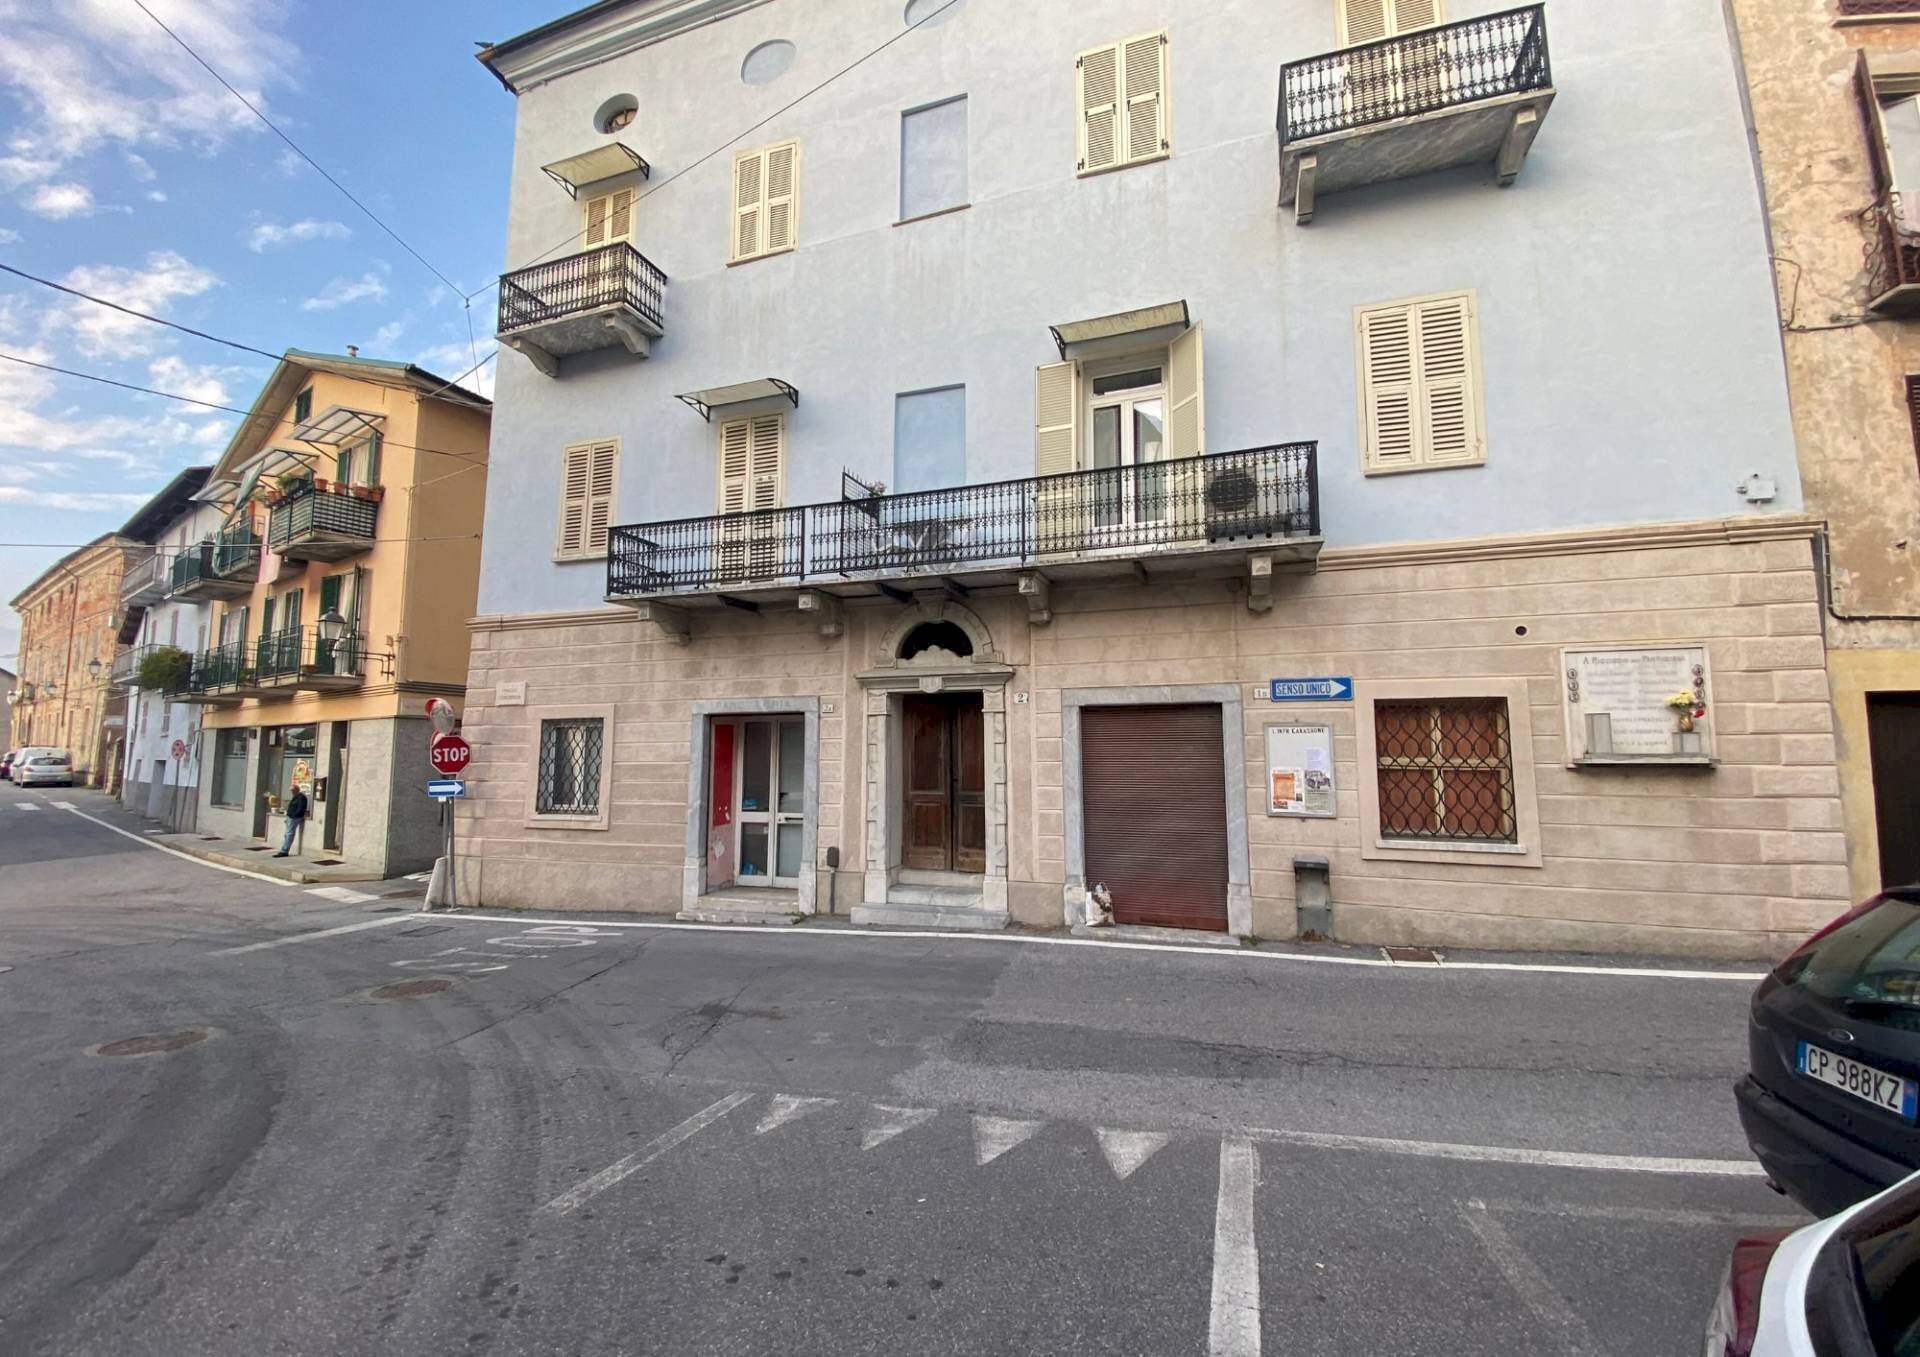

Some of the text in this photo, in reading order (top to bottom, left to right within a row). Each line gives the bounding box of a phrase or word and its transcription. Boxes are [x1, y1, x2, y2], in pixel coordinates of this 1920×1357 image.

[1276, 682, 1332, 696] SENSO UNICO
[433, 747, 469, 763] STOP
[1808, 1048, 1900, 1109] CP 988KZ
